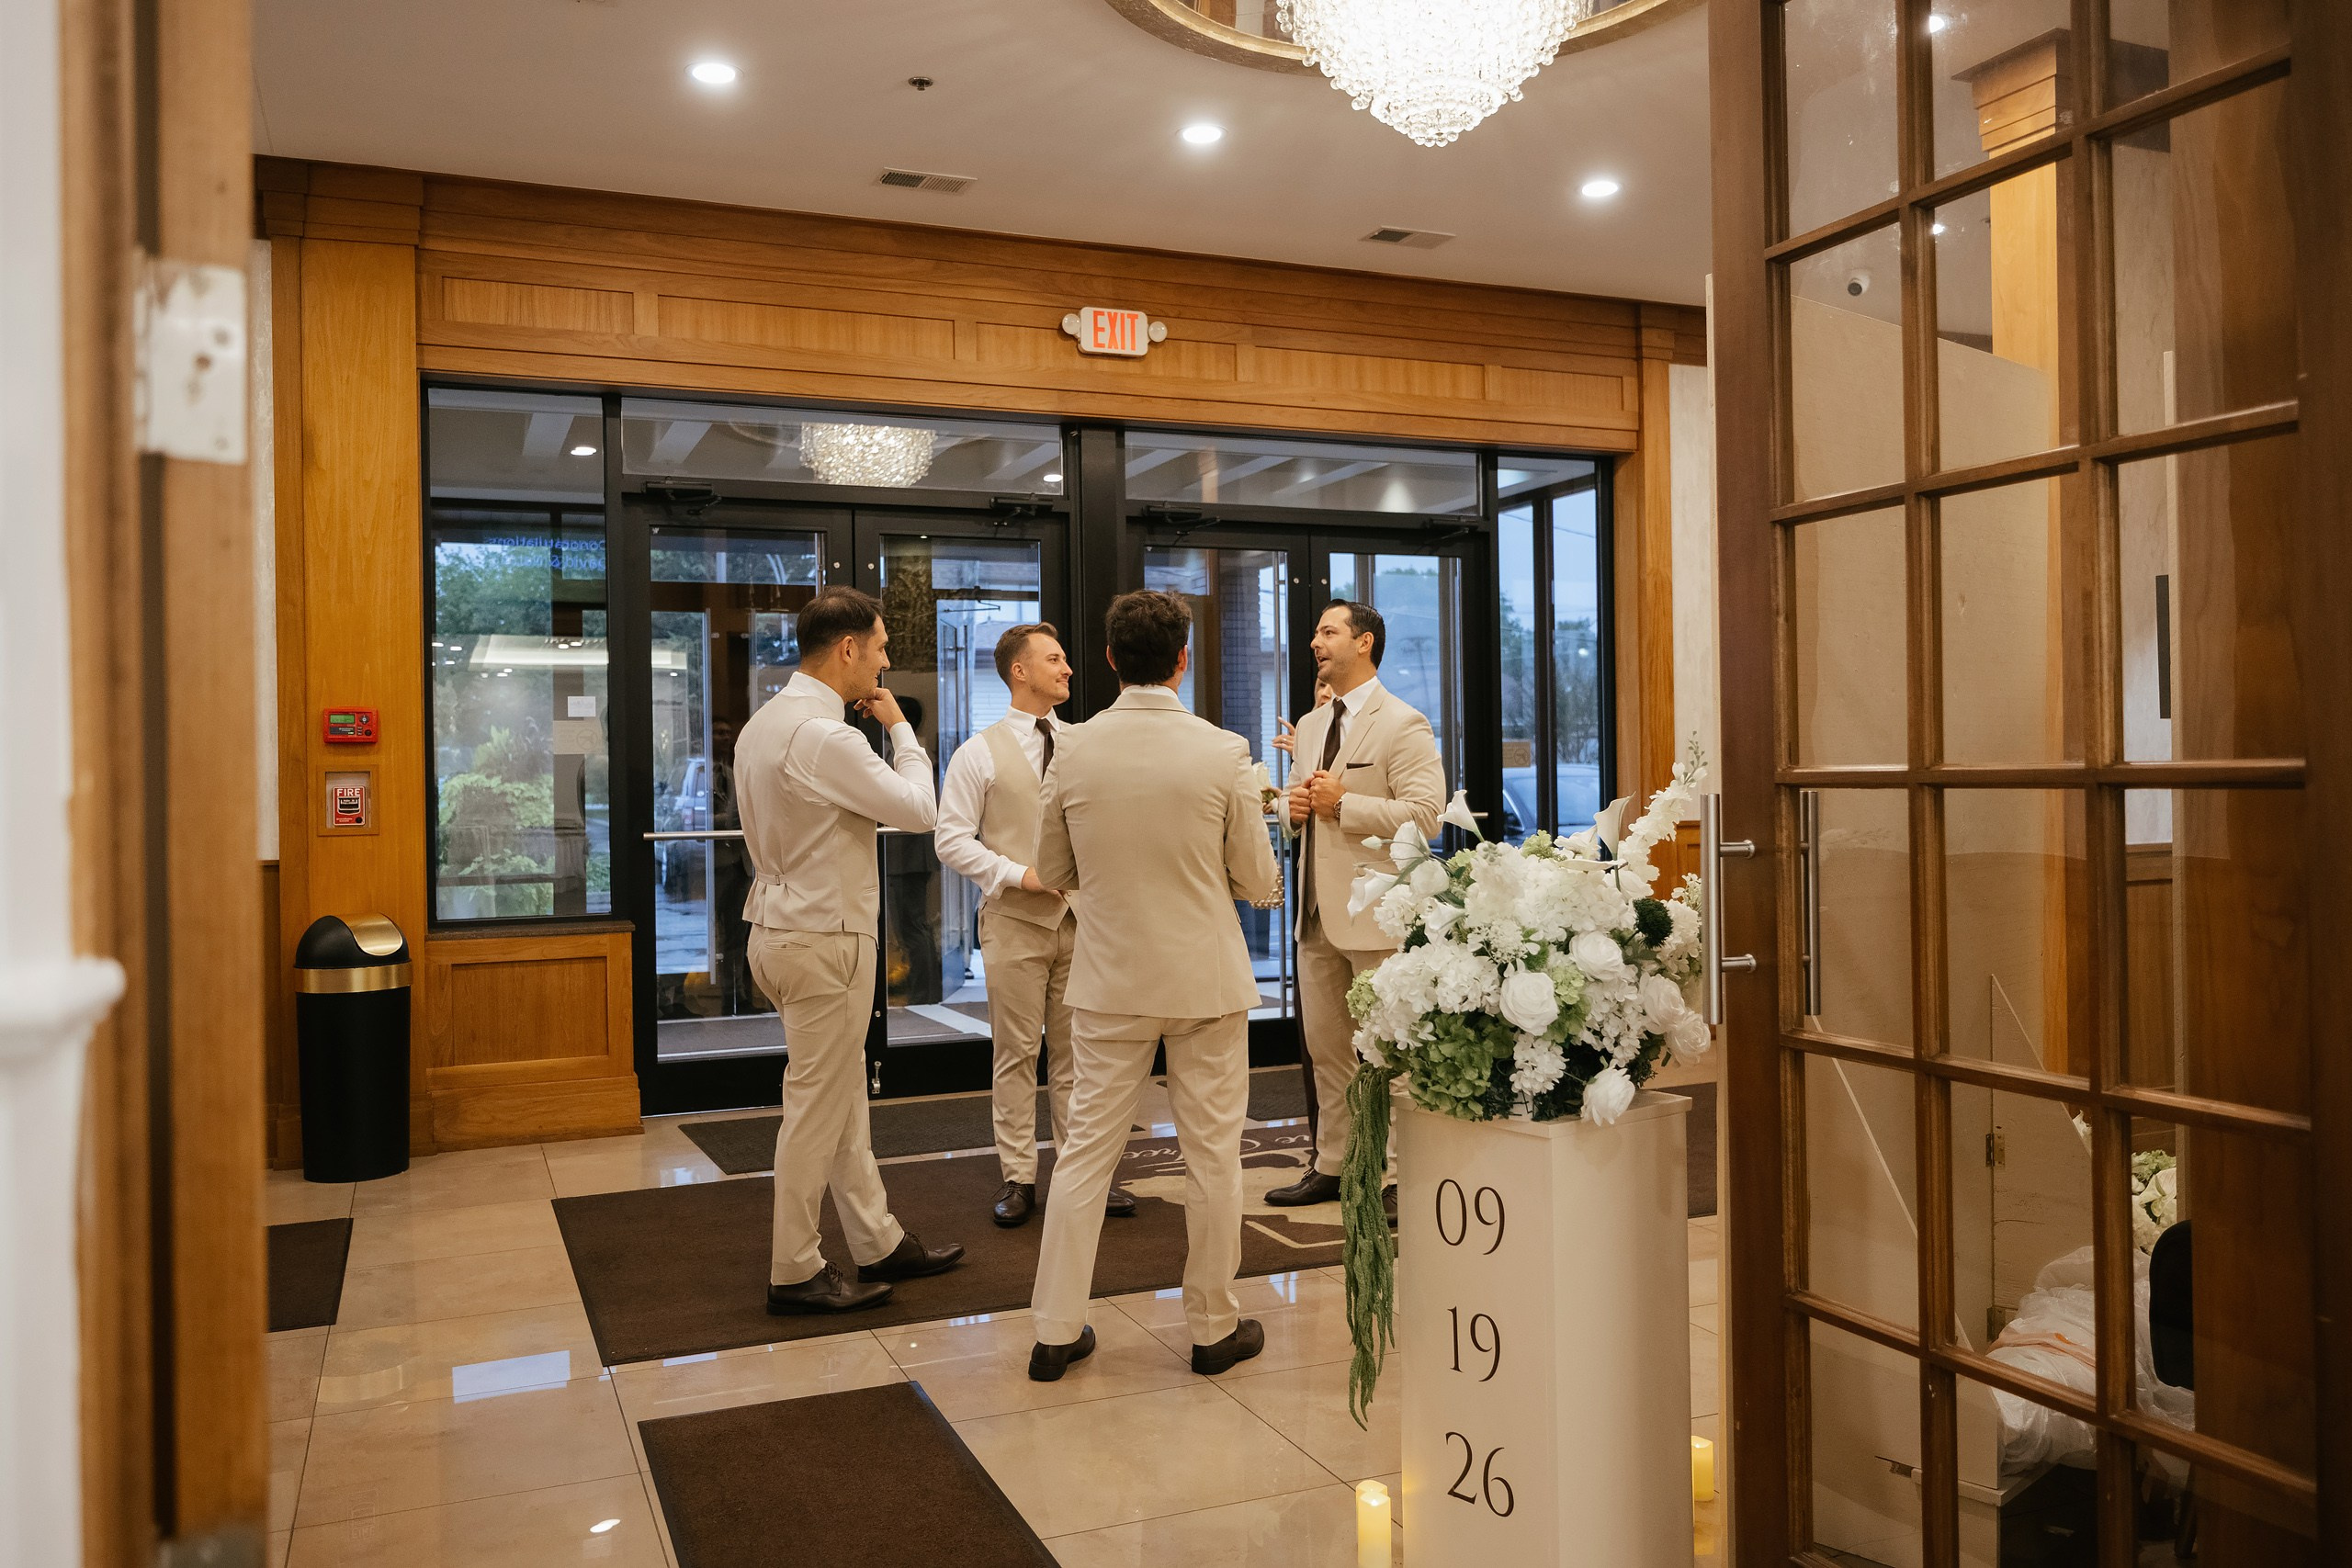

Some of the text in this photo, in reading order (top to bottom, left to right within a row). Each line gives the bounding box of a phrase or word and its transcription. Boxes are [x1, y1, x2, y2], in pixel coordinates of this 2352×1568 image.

[1092, 310, 1139, 351] EXIT
[336, 788, 361, 796] FIRE
[1435, 1179, 1505, 1256] 09
[1447, 1305, 1501, 1382] 19
[1445, 1431, 1514, 1517] 26
